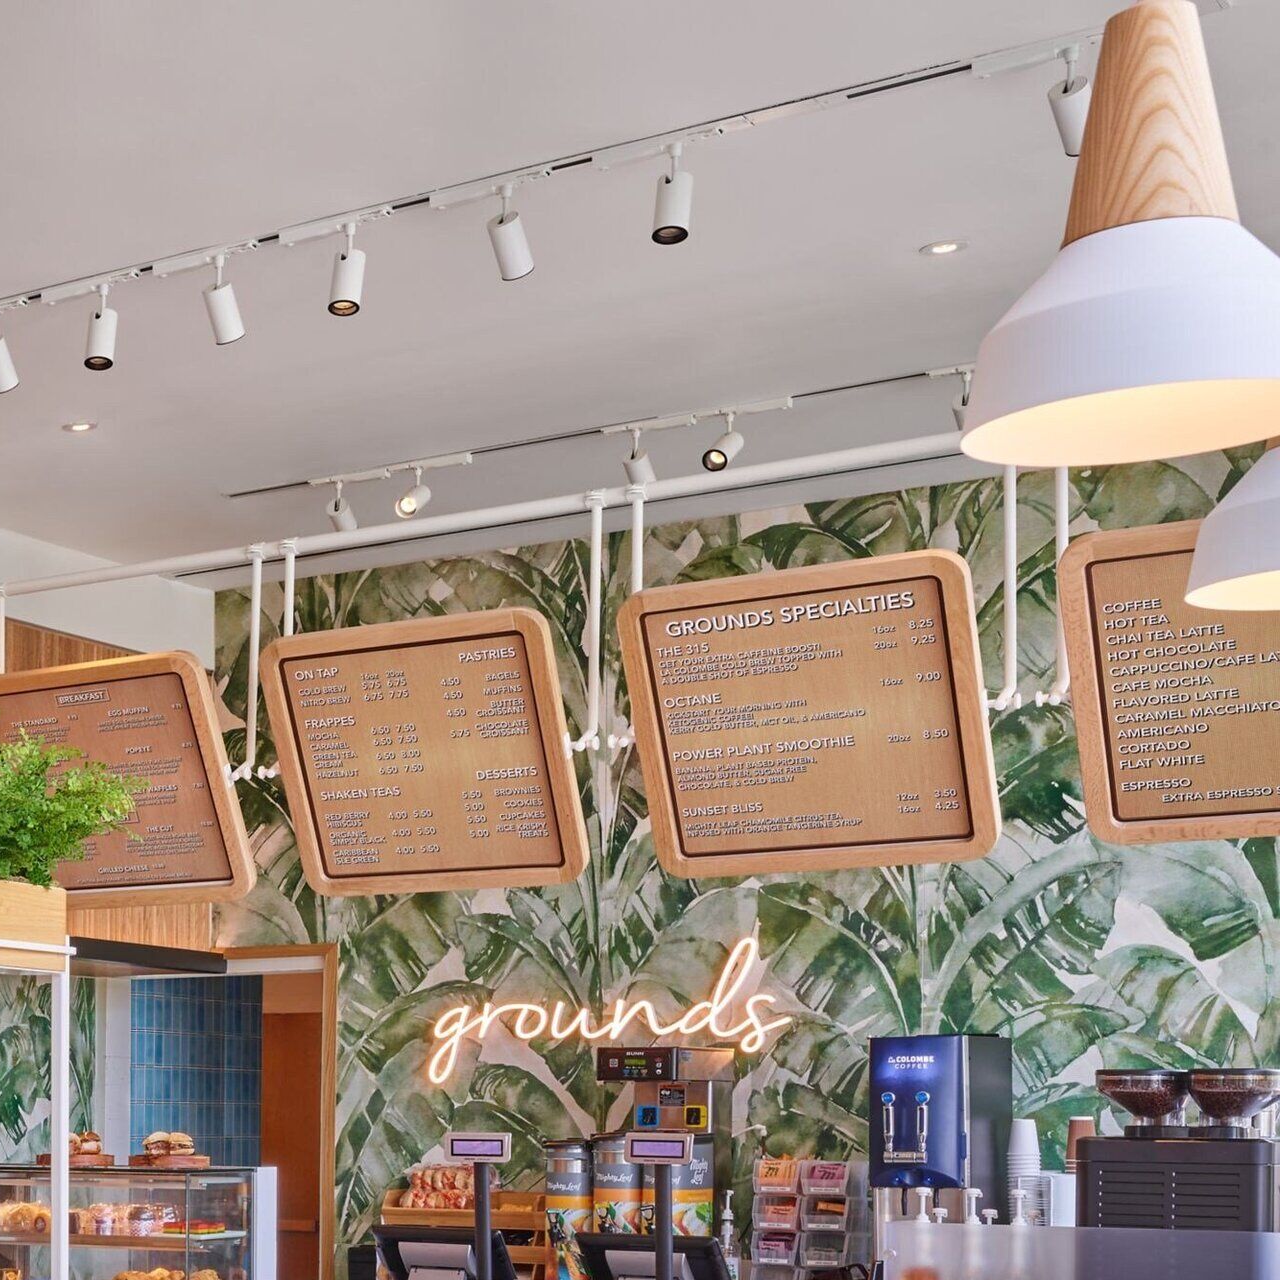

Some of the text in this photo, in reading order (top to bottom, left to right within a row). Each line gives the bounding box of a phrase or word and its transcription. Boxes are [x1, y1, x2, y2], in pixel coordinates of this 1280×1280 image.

[1103, 599, 1162, 614] COFFEE
[666, 592, 915, 637] GROUNDS SPECIALTIES
[1104, 614, 1169, 630] HOT TEA
[872, 619, 934, 634] 16oz 8.25
[911, 634, 935, 645] 9.25
[1106, 624, 1225, 646] CHAI TEA LATTE
[458, 647, 516, 663] PASTRIES
[657, 643, 709, 658] THE 315
[737, 647, 783, 660] CAFFEINE
[785, 643, 821, 654] BOOST!
[1108, 640, 1237, 662] HOT CHOCOLATE
[674, 664, 719, 675] COLOMBE
[721, 660, 746, 670] COLD
[750, 657, 775, 668] BREW
[778, 652, 815, 664] TOPPED
[819, 649, 842, 659] WITH
[1110, 653, 1255, 678] CAPPUCCINO/CAFE
[295, 667, 339, 681] ON TAP
[441, 671, 520, 686] 4.50 BAGELS
[879, 671, 941, 687] 16oz 9.00
[323, 685, 346, 694] BREW
[361, 681, 381, 690] 5.75
[387, 679, 407, 688] 6.75
[1111, 675, 1214, 693] CAFE MOCHA
[58, 691, 105, 705] BREAKFAST
[300, 699, 327, 708] NITRO
[364, 693, 383, 702] 6.75
[389, 690, 409, 699] 7.75
[444, 685, 523, 700] 4.50 MUFFINS
[1113, 688, 1240, 709] FLAVORED LATTE
[447, 699, 525, 717] 4.50 BUTTER
[664, 693, 722, 709] OCTANE
[476, 706, 526, 718] CROISSANT
[1115, 709, 1187, 725] CARAMEL
[305, 715, 356, 729] FRAPPES
[450, 720, 529, 738] 5.75 CHOCOLATE
[480, 727, 530, 739] CROISSANT
[922, 728, 949, 740] 8.50
[1117, 722, 1209, 740] AMERICANO
[673, 735, 855, 762] POWER PLANT SMOOTHIE
[1118, 740, 1191, 755] CORTADO
[1120, 755, 1205, 770] FLAT WHITE
[477, 766, 538, 781] DESSERTS
[494, 785, 542, 797] BROWNIES
[1121, 778, 1192, 792] ESPRESSO
[321, 786, 401, 801] SHAKEN TEAS
[896, 788, 957, 801] 12oz 3.50
[1162, 787, 1273, 804] EXTRA ESPRESSO
[504, 797, 544, 808] COOKIES
[682, 802, 764, 818] SUNSET BLISS
[897, 800, 959, 814] 16oz 4.25
[500, 810, 546, 822] CUPCAKES
[429, 938, 792, 1084] grounds
